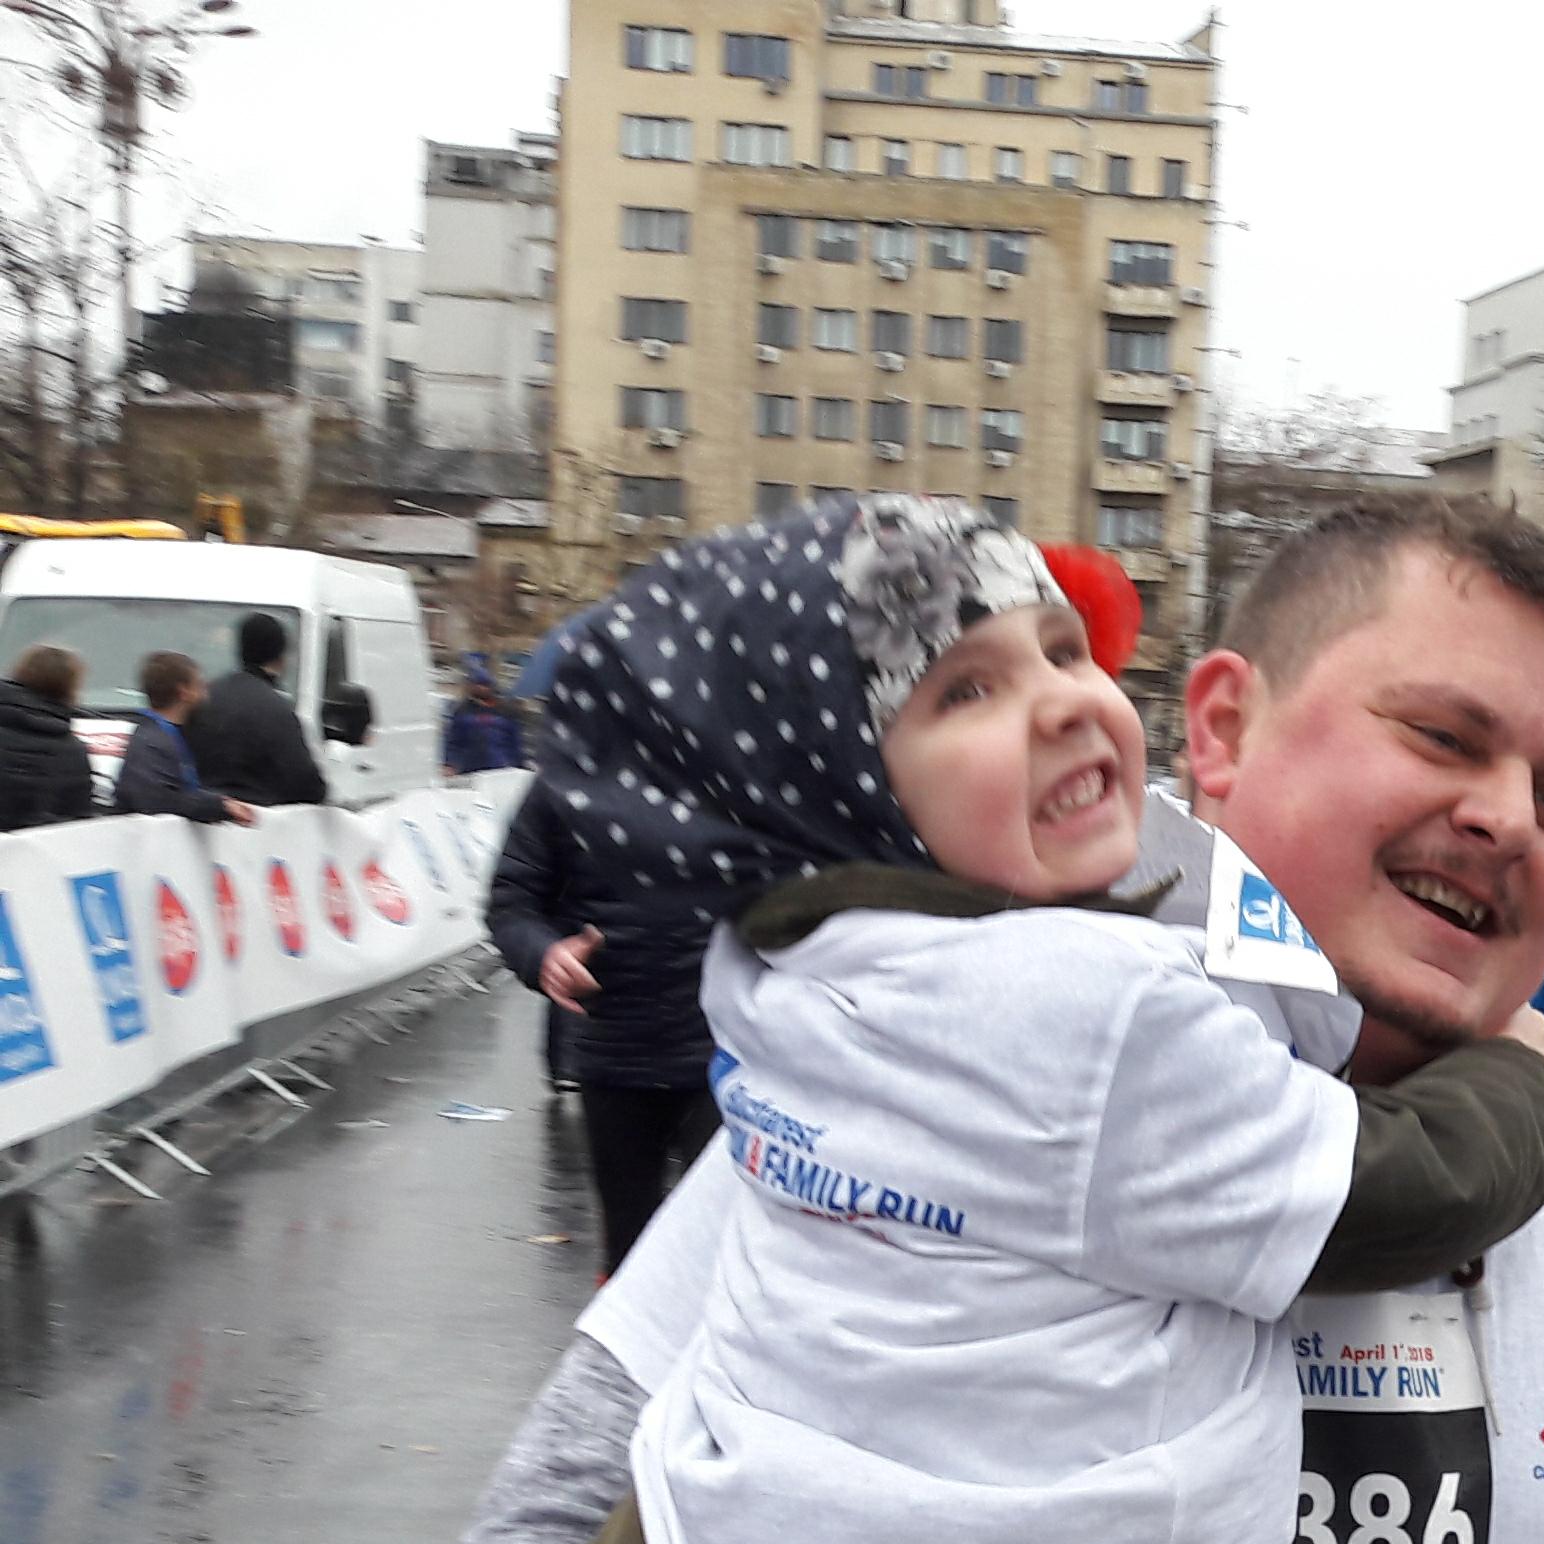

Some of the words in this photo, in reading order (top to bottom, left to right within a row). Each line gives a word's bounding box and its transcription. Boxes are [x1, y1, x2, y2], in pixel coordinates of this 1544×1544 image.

[764, 1144, 871, 1213] FAMILY
[877, 1187, 965, 1235] RUN
[1292, 1331, 1323, 1358] st
[1340, 1344, 1385, 1364] April
